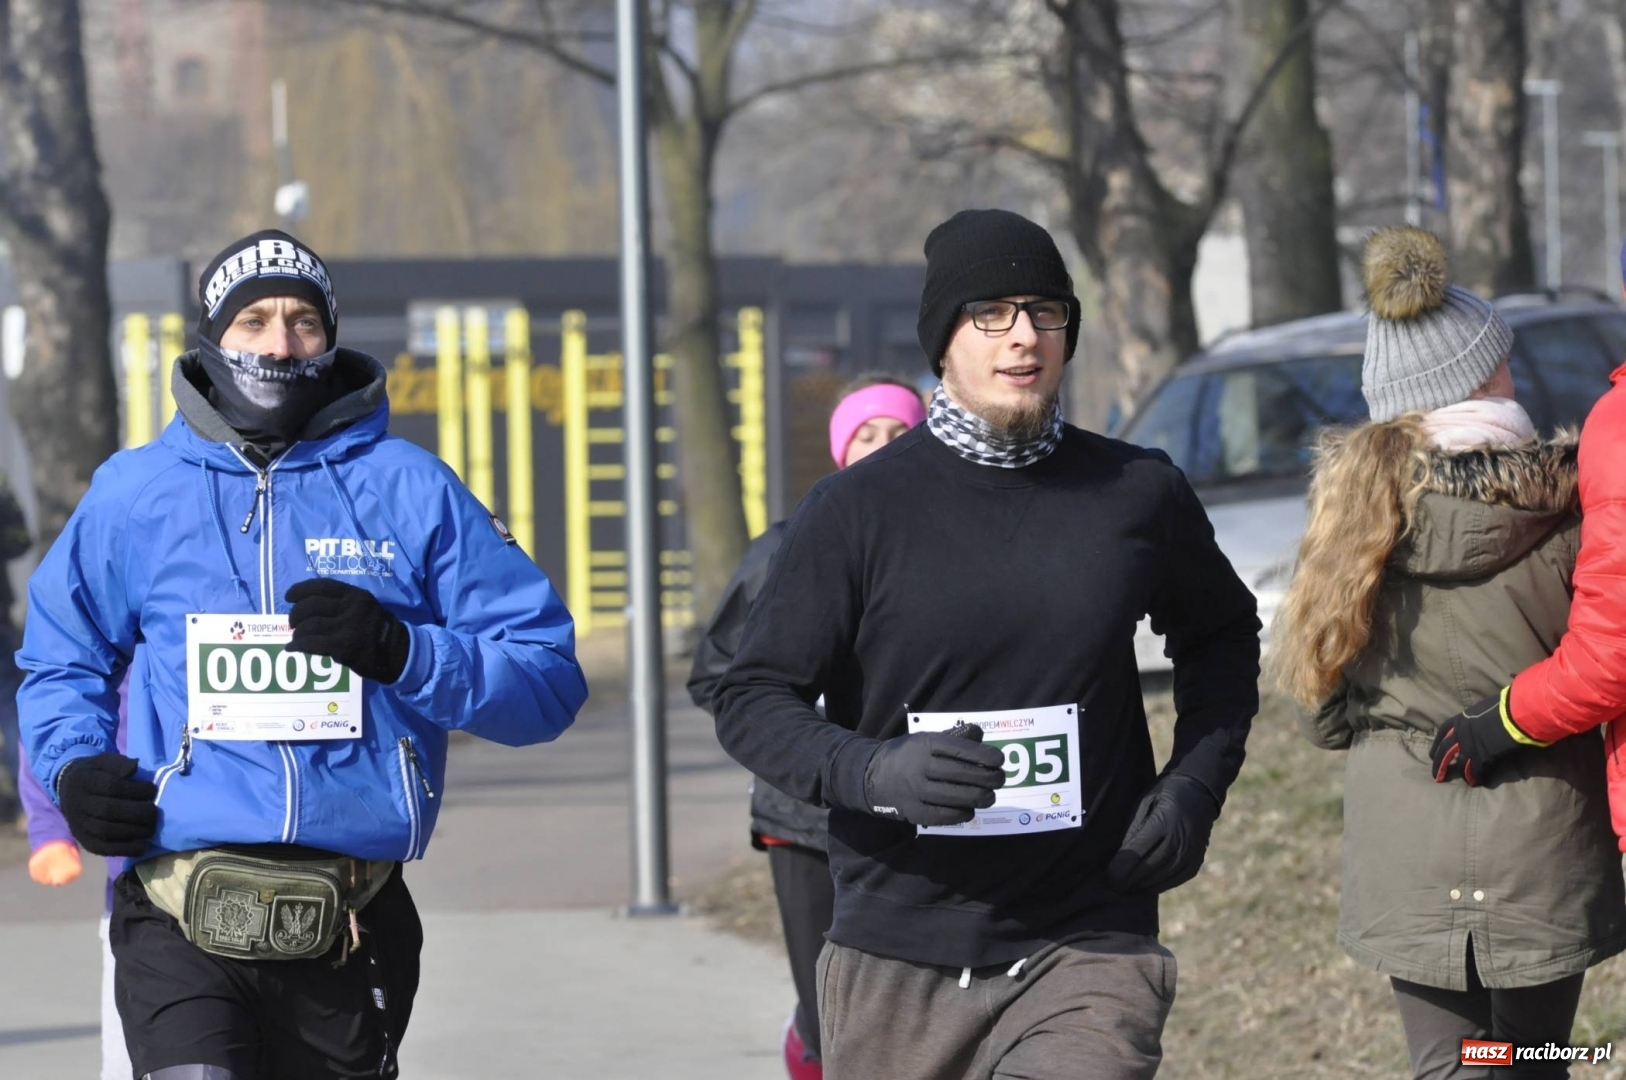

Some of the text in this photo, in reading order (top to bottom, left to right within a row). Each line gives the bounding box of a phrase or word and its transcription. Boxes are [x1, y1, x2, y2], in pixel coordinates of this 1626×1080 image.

[306, 555, 345, 570] WEST
[206, 647, 343, 692] 0009
[320, 720, 349, 729] PGNiG
[1001, 739, 1063, 787] 95
[1045, 810, 1071, 821] PGNiG
